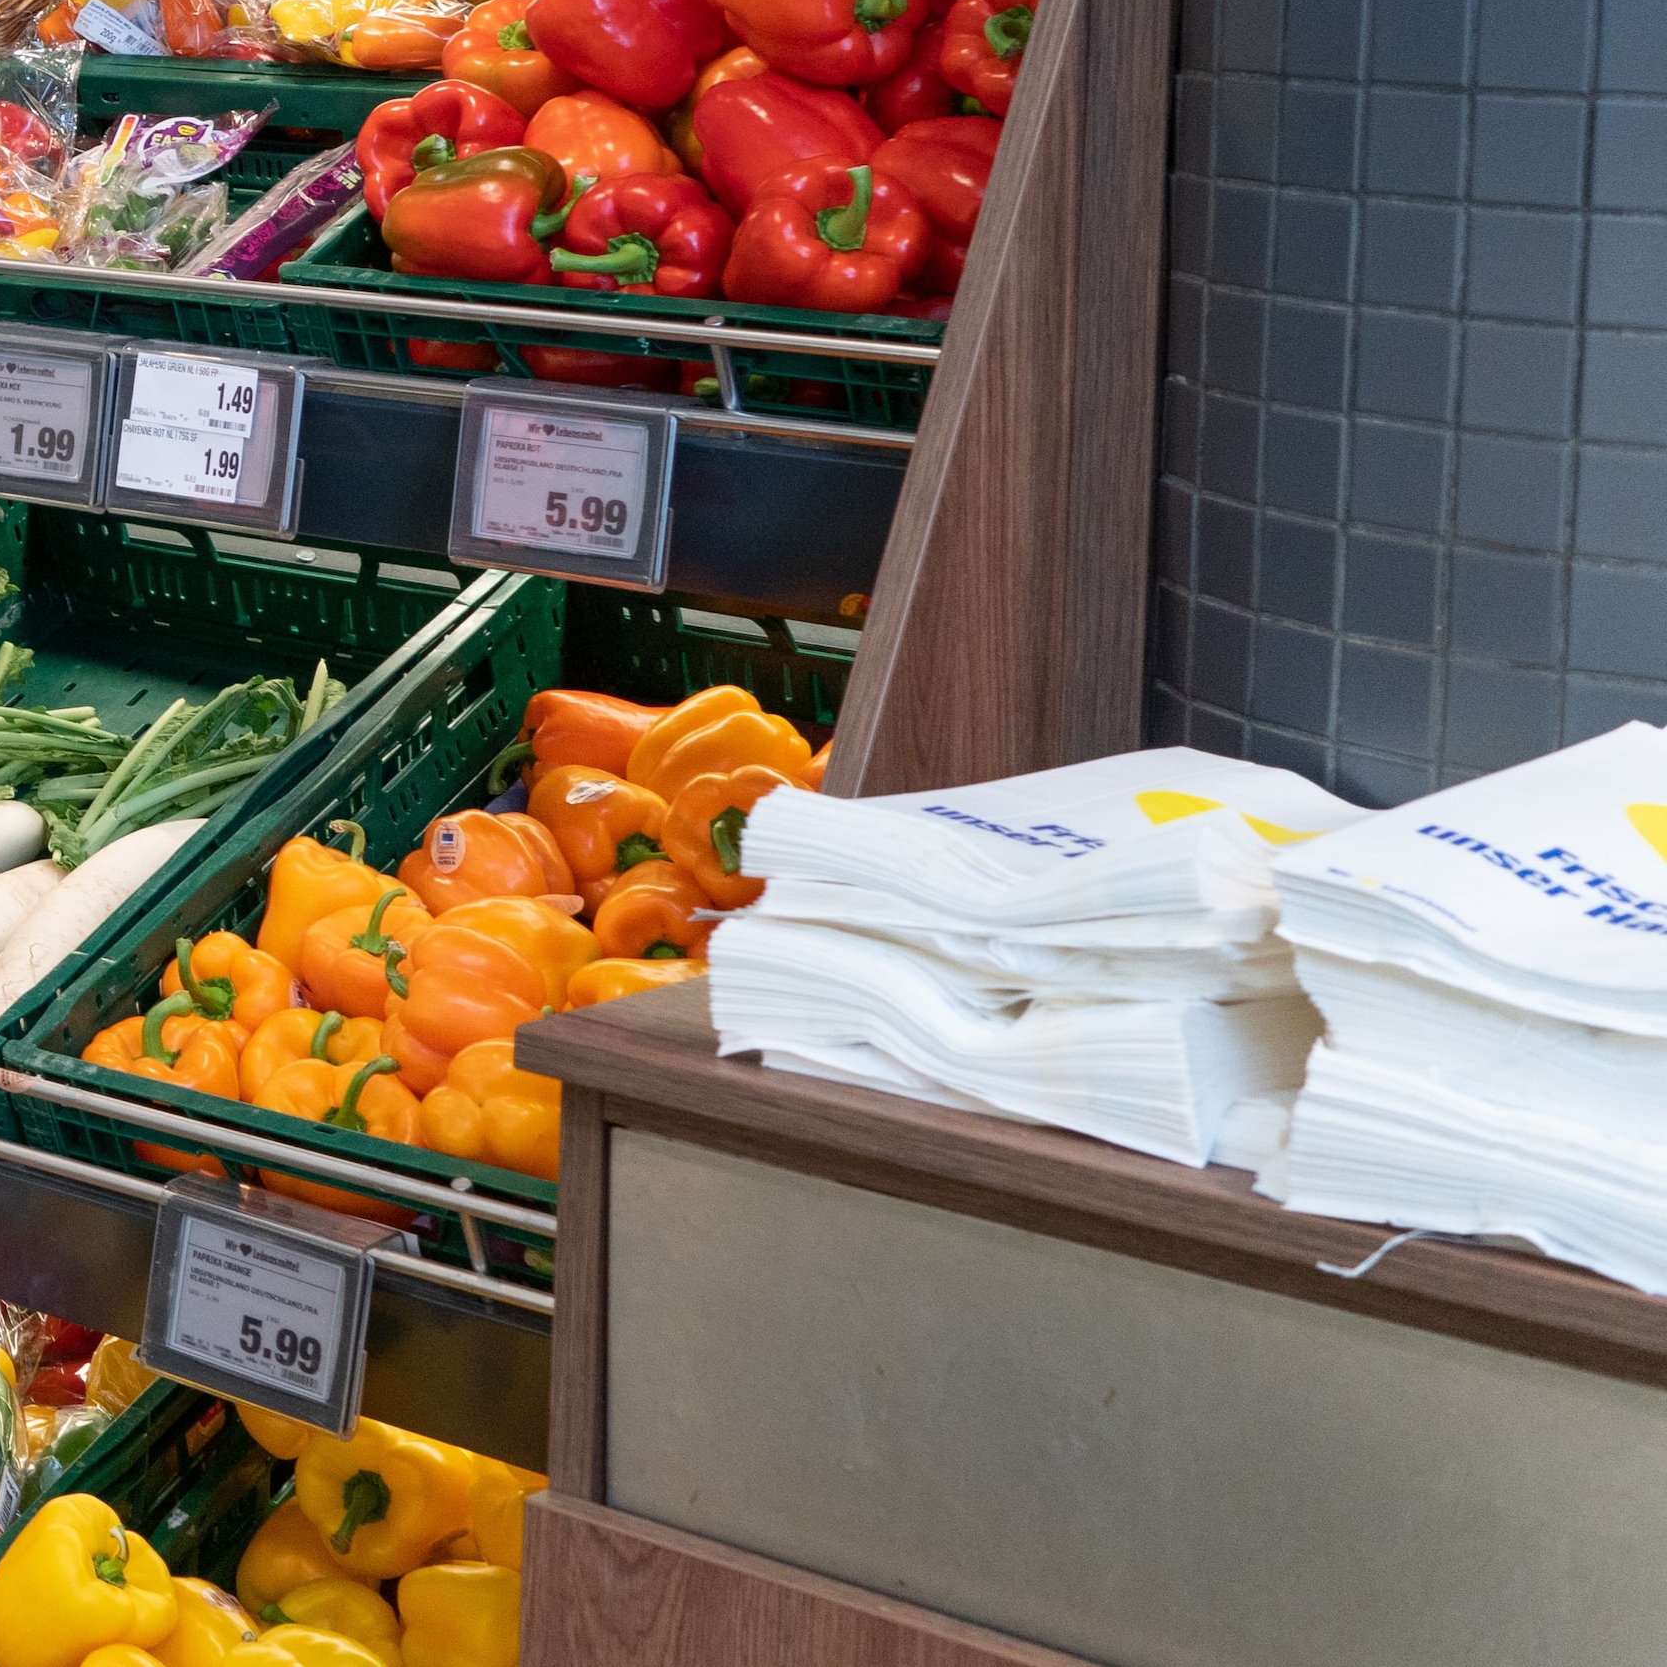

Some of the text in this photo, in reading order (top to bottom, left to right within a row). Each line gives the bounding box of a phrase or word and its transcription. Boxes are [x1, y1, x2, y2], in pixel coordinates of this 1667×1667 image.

[99, 27, 117, 44] 200g
[167, 362, 186, 374] GRUEN
[186, 364, 195, 374] NL
[9, 383, 21, 393] MIX
[217, 382, 254, 415] 1.49
[10, 422, 76, 463] 1.99
[123, 422, 152, 437] CHAYENNE
[153, 427, 166, 438] ROT
[495, 440, 542, 454] PAPRIKA ROT
[204, 448, 240, 480] 1.99
[545, 490, 629, 537] 5.99
[922, 805, 1065, 849] unser
[1416, 824, 1581, 900] unser
[1585, 902, 1667, 936] Ha
[1536, 847, 1667, 912] Frisc
[192, 1249, 252, 1277] PAPRIKA ORANGE
[238, 1312, 323, 1377] 5.99
